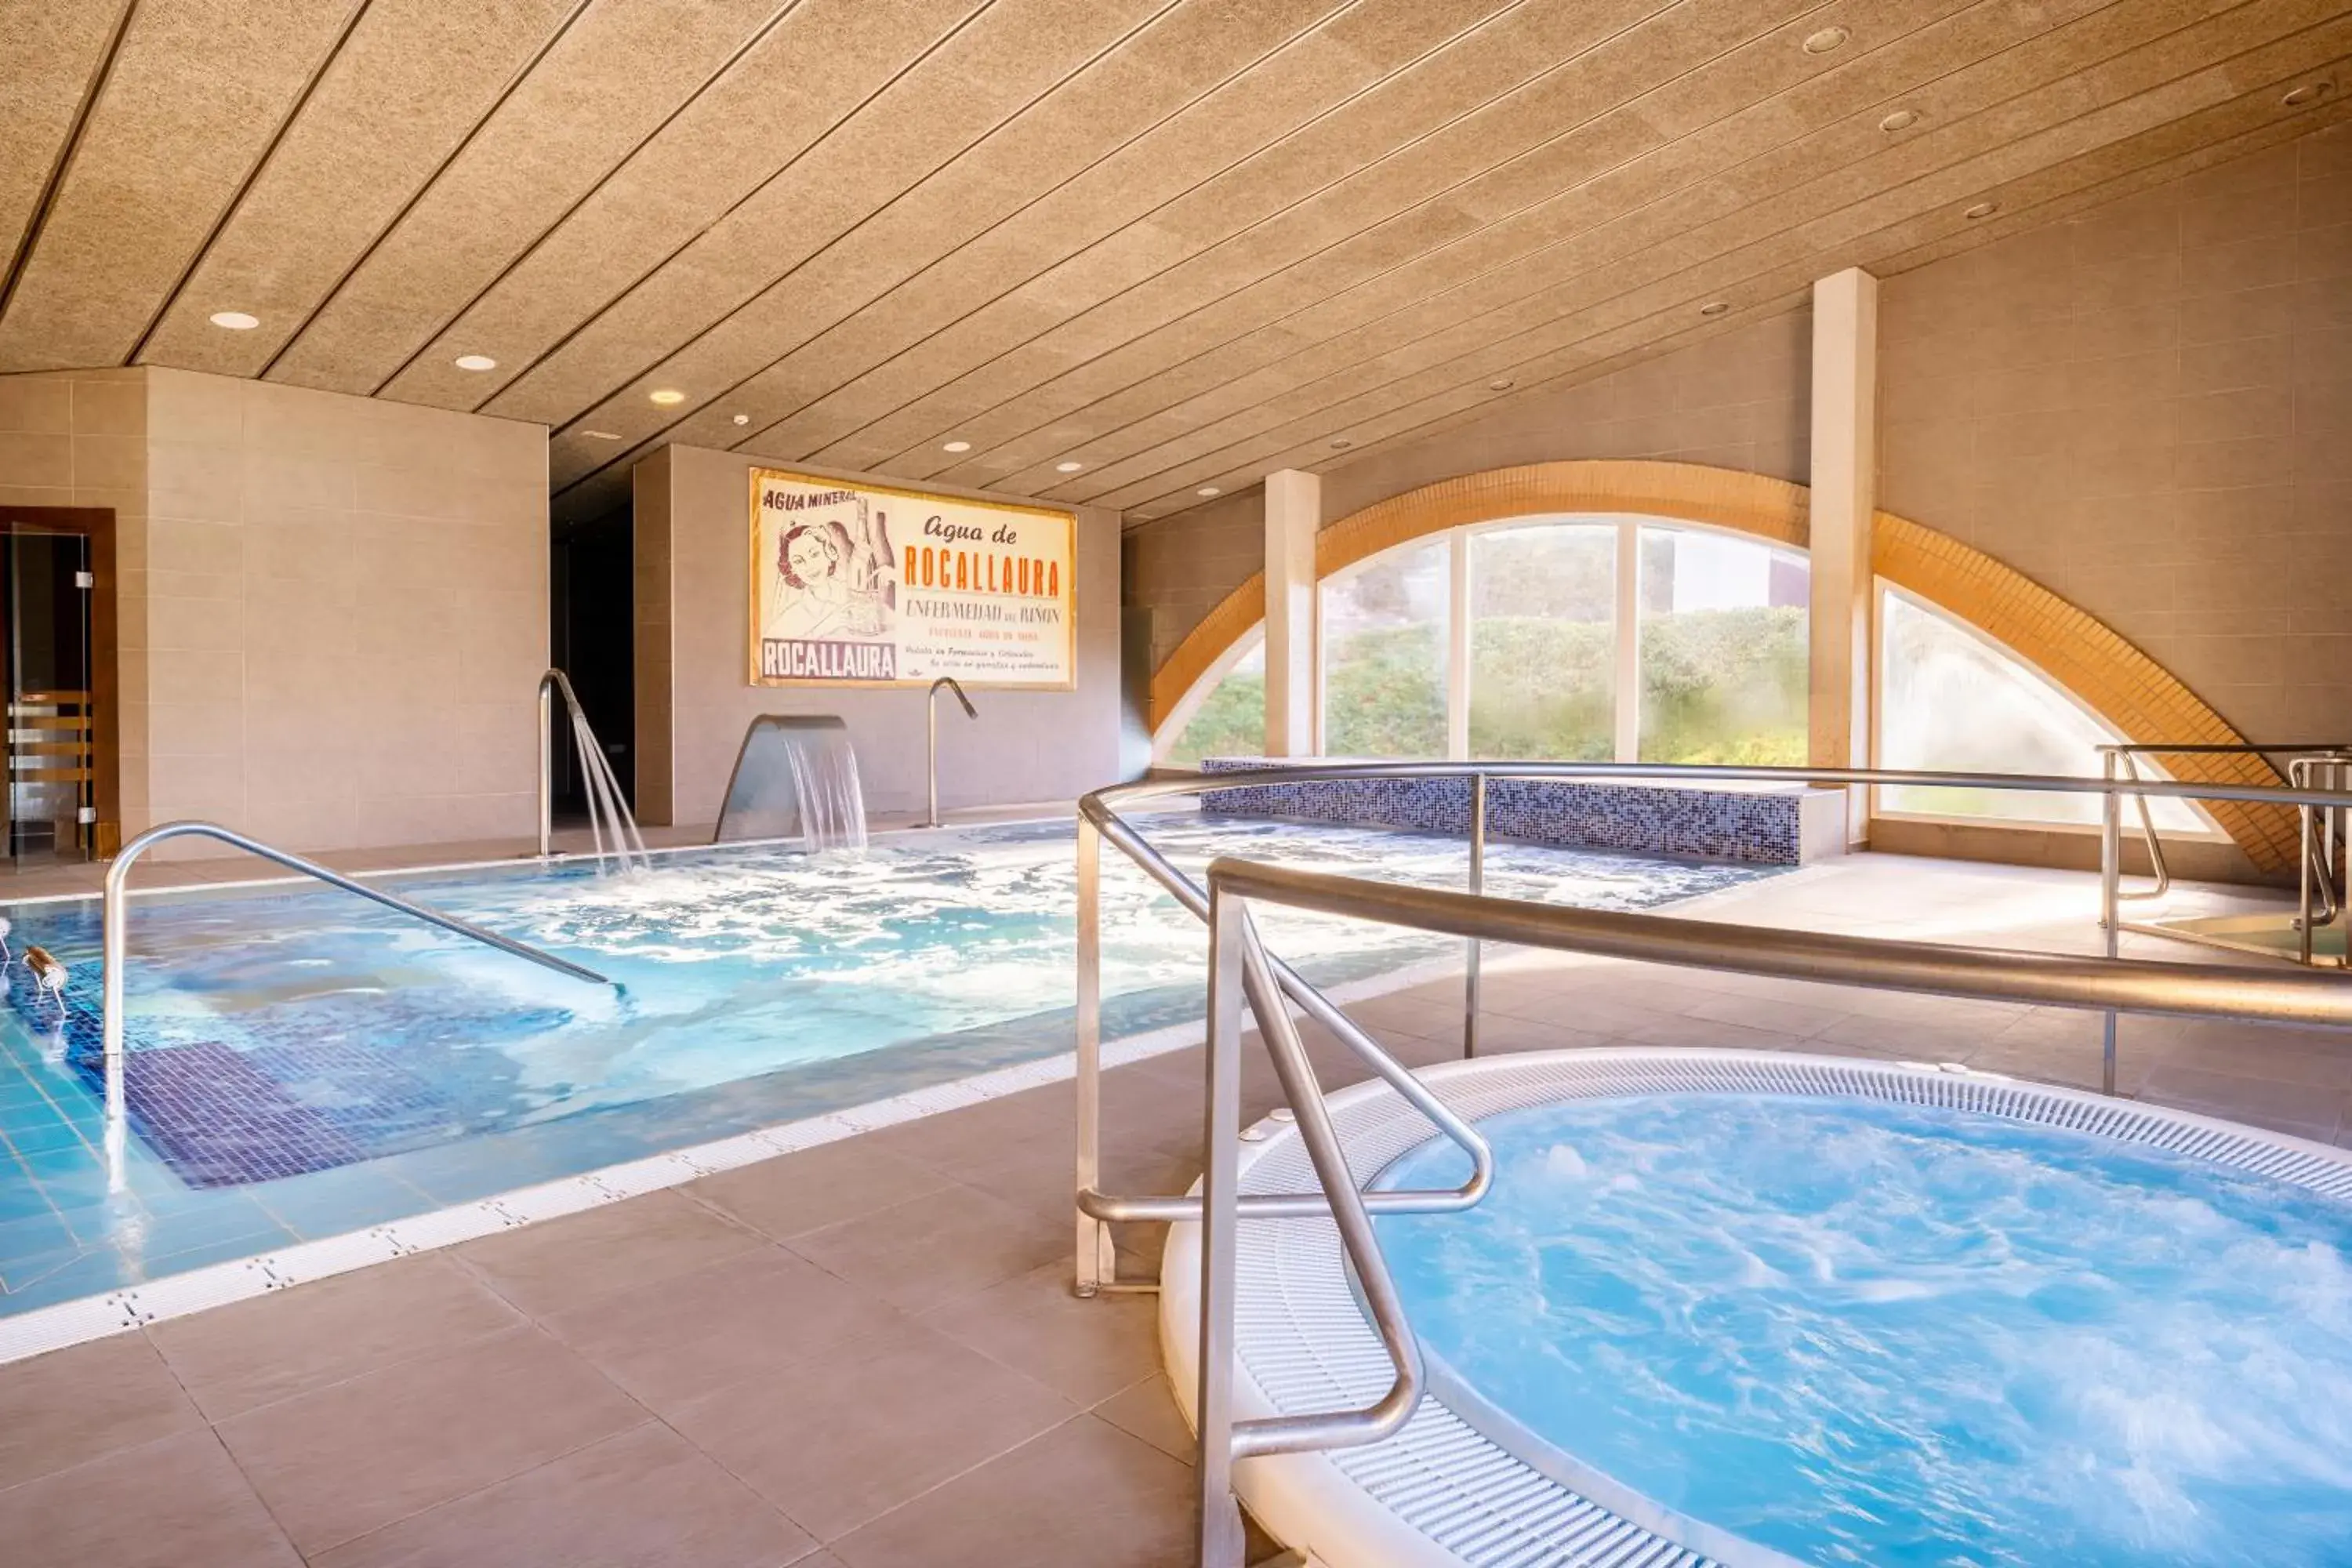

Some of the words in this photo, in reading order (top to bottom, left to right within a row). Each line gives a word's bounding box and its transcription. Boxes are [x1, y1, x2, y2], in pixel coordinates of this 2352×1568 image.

[763, 489, 804, 510] AGUA
[808, 490, 857, 508] MINERAL
[924, 515, 984, 543] Agua
[992, 524, 1018, 544] de
[904, 546, 1059, 597] ROCALLAURA
[906, 599, 1002, 622] ENFERMEDAD
[764, 641, 895, 678] ROCALLAURA
